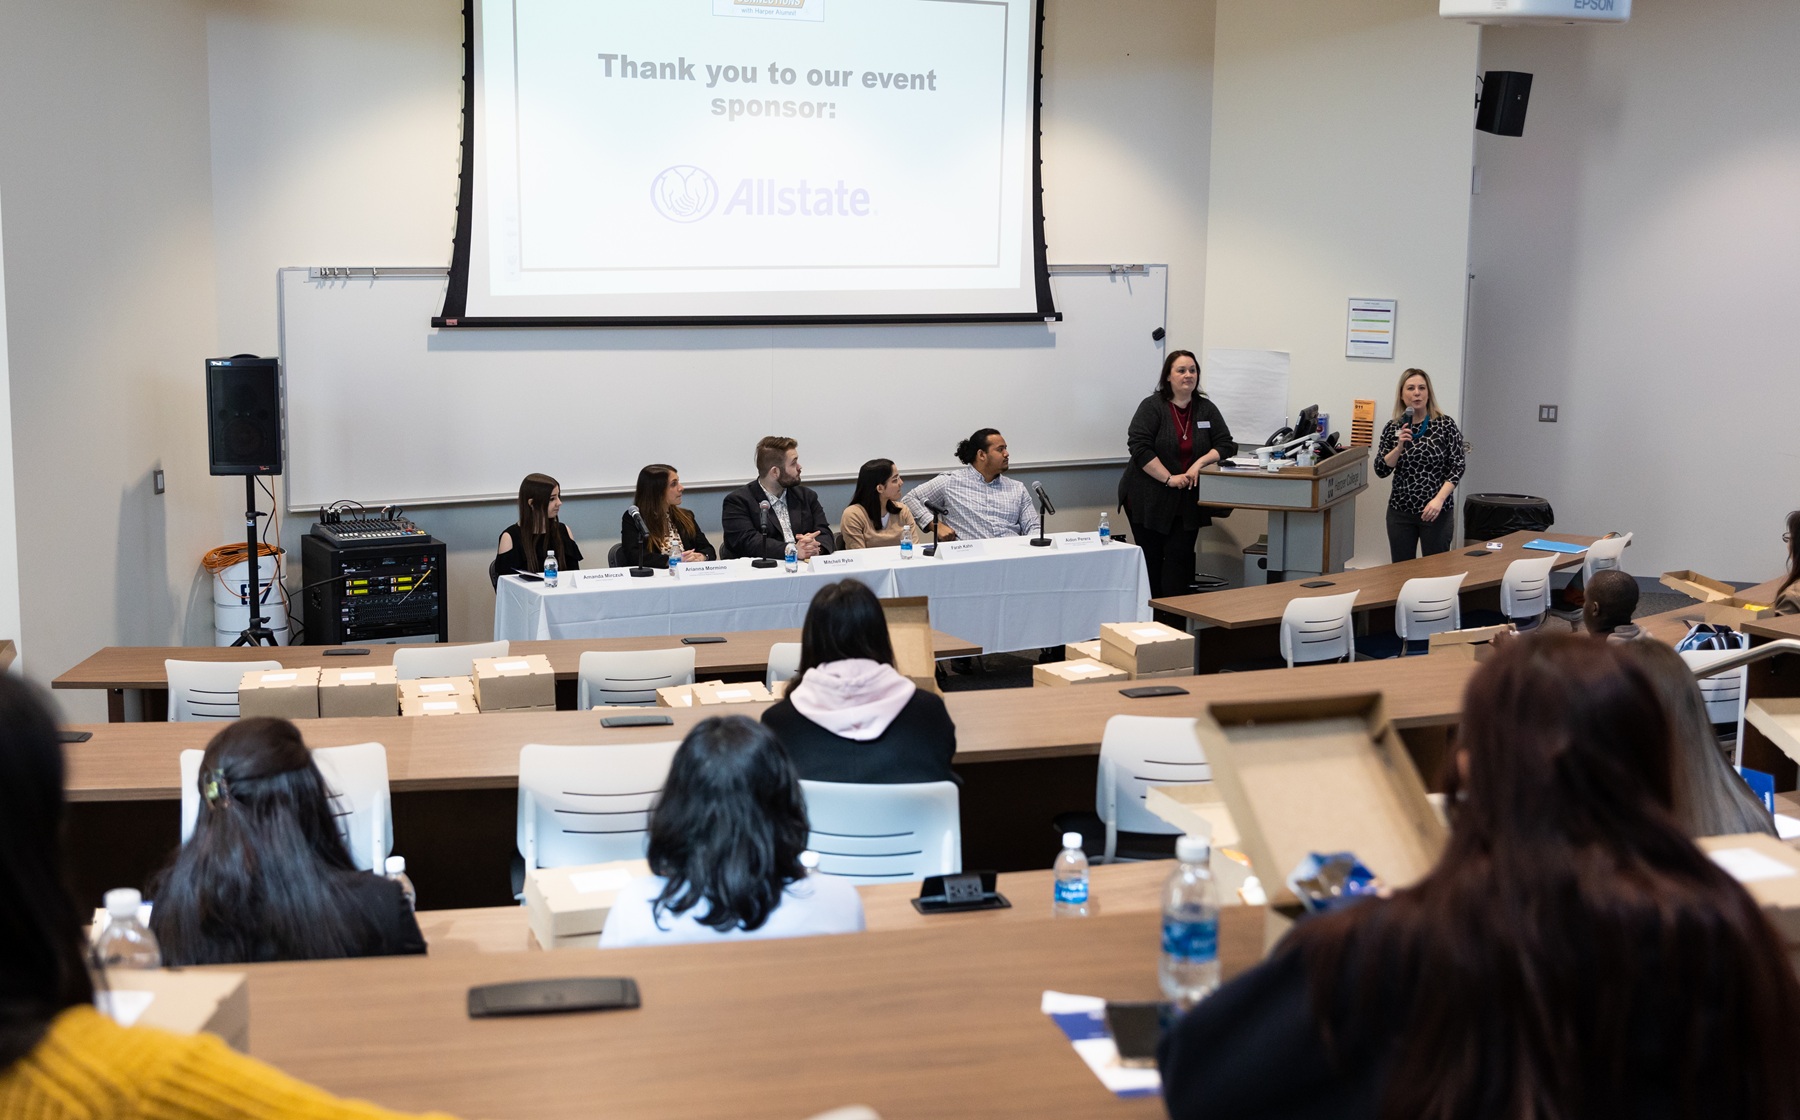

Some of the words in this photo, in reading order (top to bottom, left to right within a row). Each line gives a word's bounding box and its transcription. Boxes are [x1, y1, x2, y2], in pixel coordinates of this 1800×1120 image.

[1574, 0, 1614, 11] EPSON
[597, 53, 696, 81] Thank
[705, 64, 758, 88] you
[768, 62, 797, 85] to
[806, 68, 853, 88] our
[861, 69, 937, 91] event
[711, 97, 836, 122] sponsor:
[722, 178, 871, 217] Allstate
